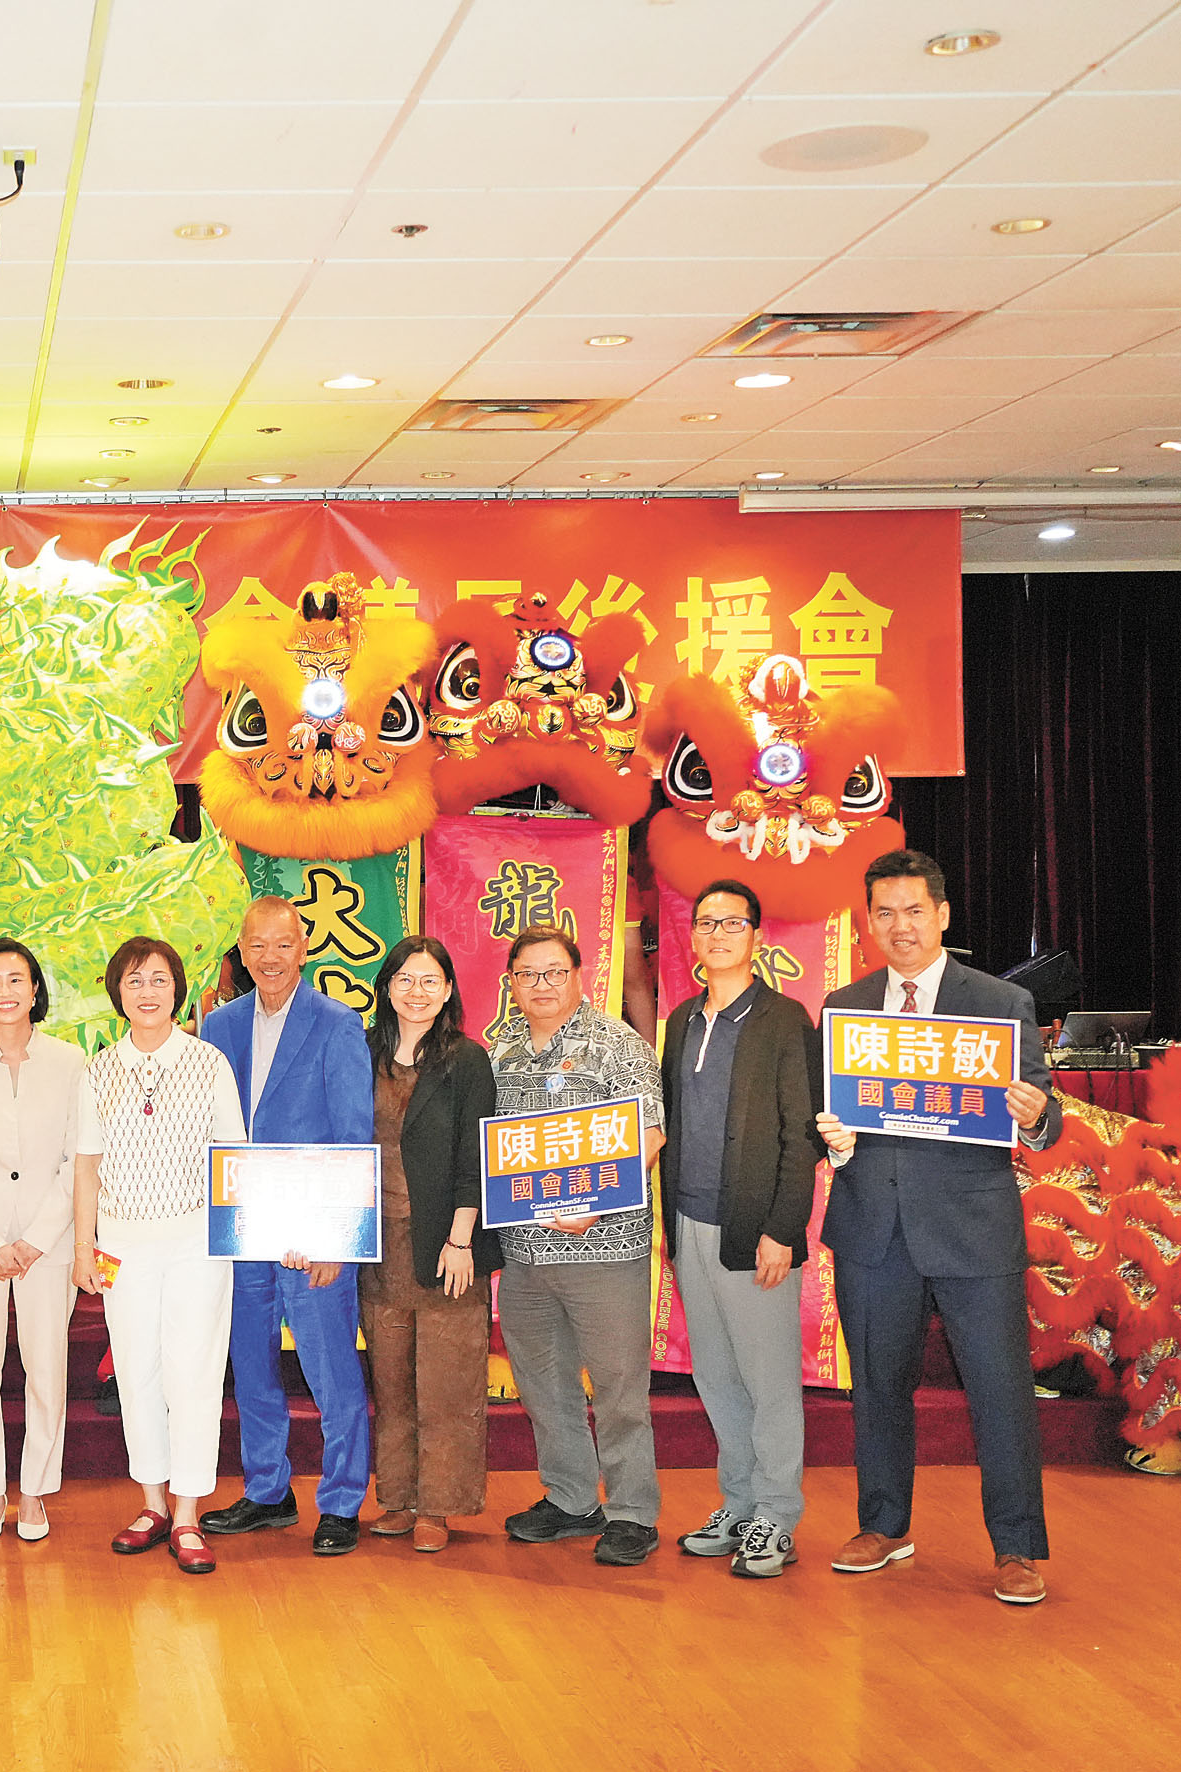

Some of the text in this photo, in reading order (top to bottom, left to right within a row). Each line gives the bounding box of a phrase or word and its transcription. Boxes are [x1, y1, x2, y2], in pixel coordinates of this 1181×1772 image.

[843, 1023, 1001, 1080] 陳詩敏
[857, 1079, 987, 1117] 國會議員
[879, 1111, 959, 1126] ConnieChanSF.com
[497, 1110, 630, 1171] 陳詩敏
[511, 1163, 620, 1203] 國會議員
[530, 1196, 599, 1210] ConnieChanSF.com
